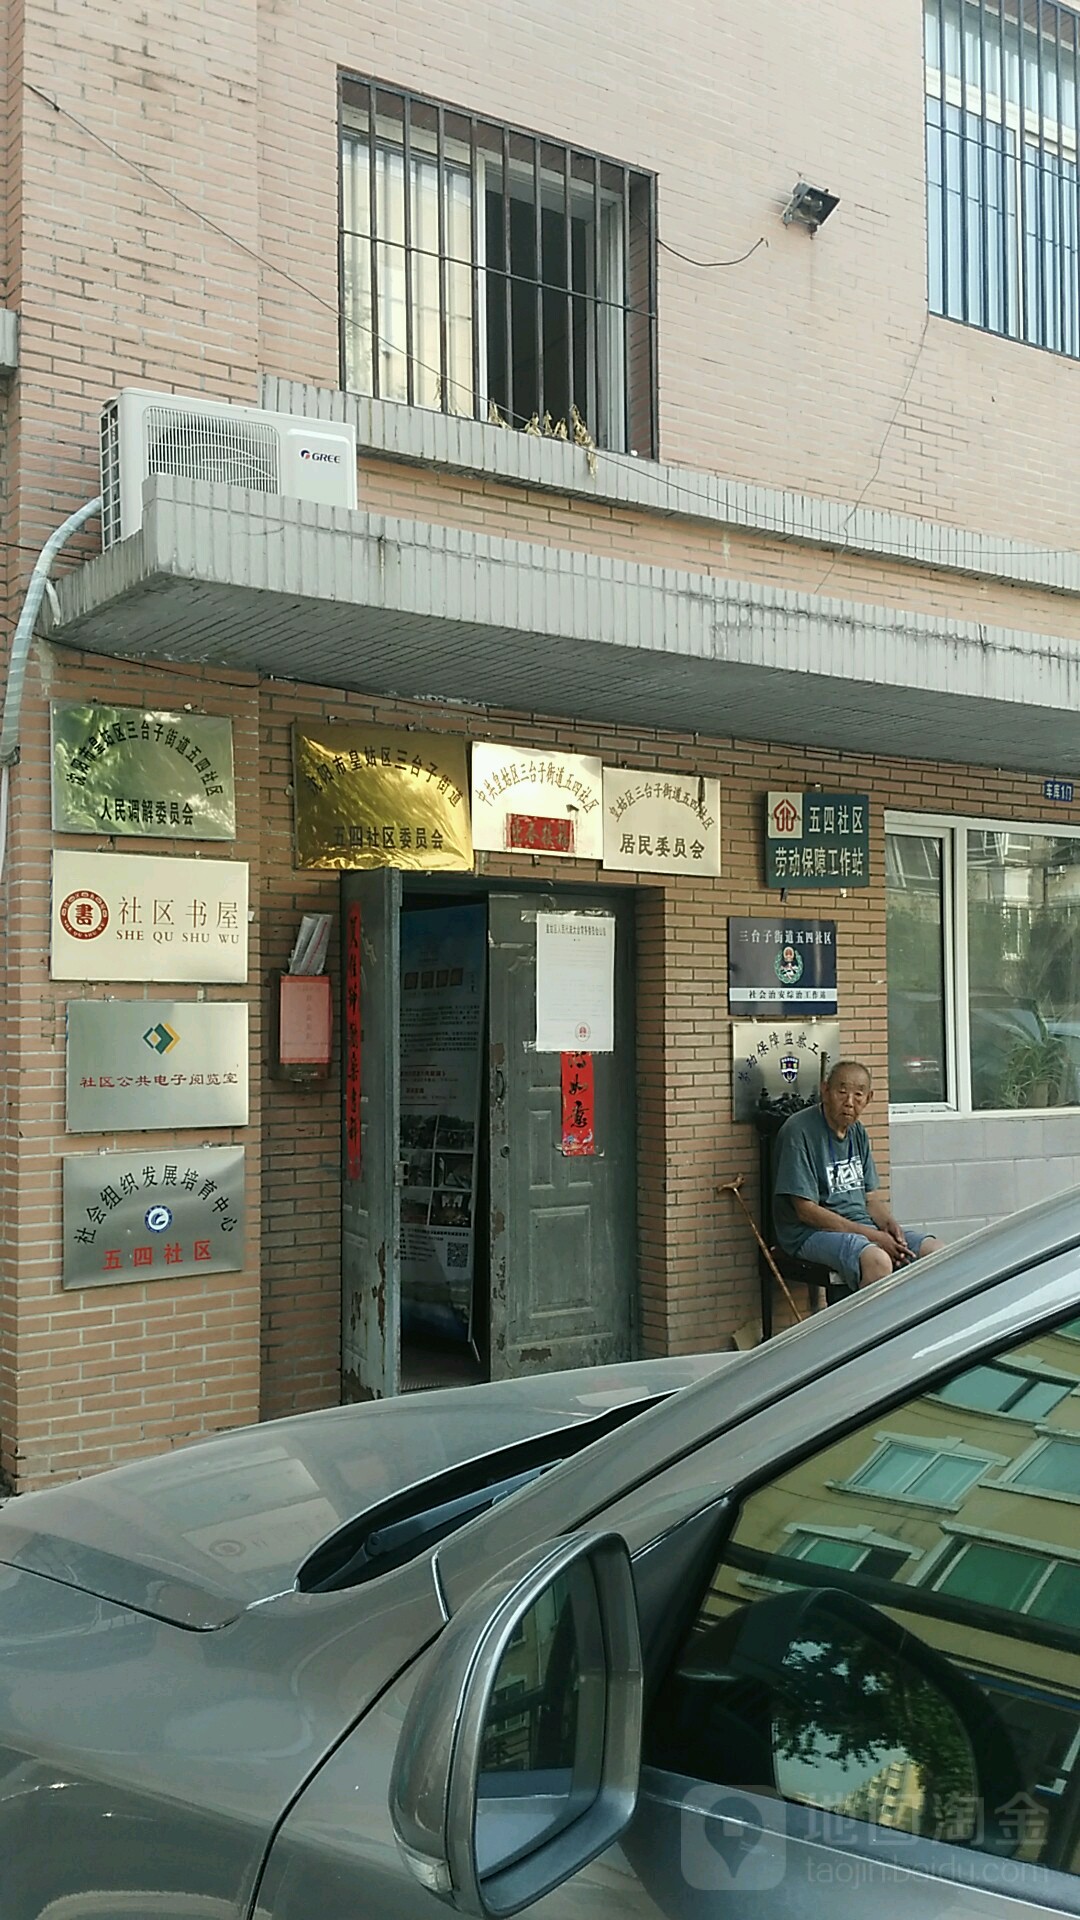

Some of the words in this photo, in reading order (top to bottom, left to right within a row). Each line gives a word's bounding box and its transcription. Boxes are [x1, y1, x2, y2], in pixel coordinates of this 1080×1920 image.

[311, 452, 341, 464] GREE
[65, 719, 224, 798] 沈阳市皇姑区三台子街道五四社区
[304, 745, 465, 808] 沈阳市皇姑区三台子街道
[474, 760, 600, 814] 中共皇姑区三台子街道五四社区
[100, 798, 195, 826] 人民调解委员会
[608, 781, 715, 833] 皇姑区三台子街道五四社区
[808, 805, 864, 835] 五四社区
[333, 825, 444, 850] 五四社区委员会
[619, 832, 706, 860] 居民委员会
[775, 846, 864, 879] 劳动保障工作站
[118, 896, 240, 931] 社区书屋
[115, 929, 145, 942] SHE
[152, 930, 174, 944] QU
[182, 931, 211, 944] SHU
[219, 932, 240, 945] WU
[738, 929, 832, 945] 三台子街道五四社区
[79, 1072, 239, 1089] 社区公共电子阅览室
[73, 1164, 239, 1246] 社会组织发展培育中心
[101, 1239, 213, 1272] 五四社区
